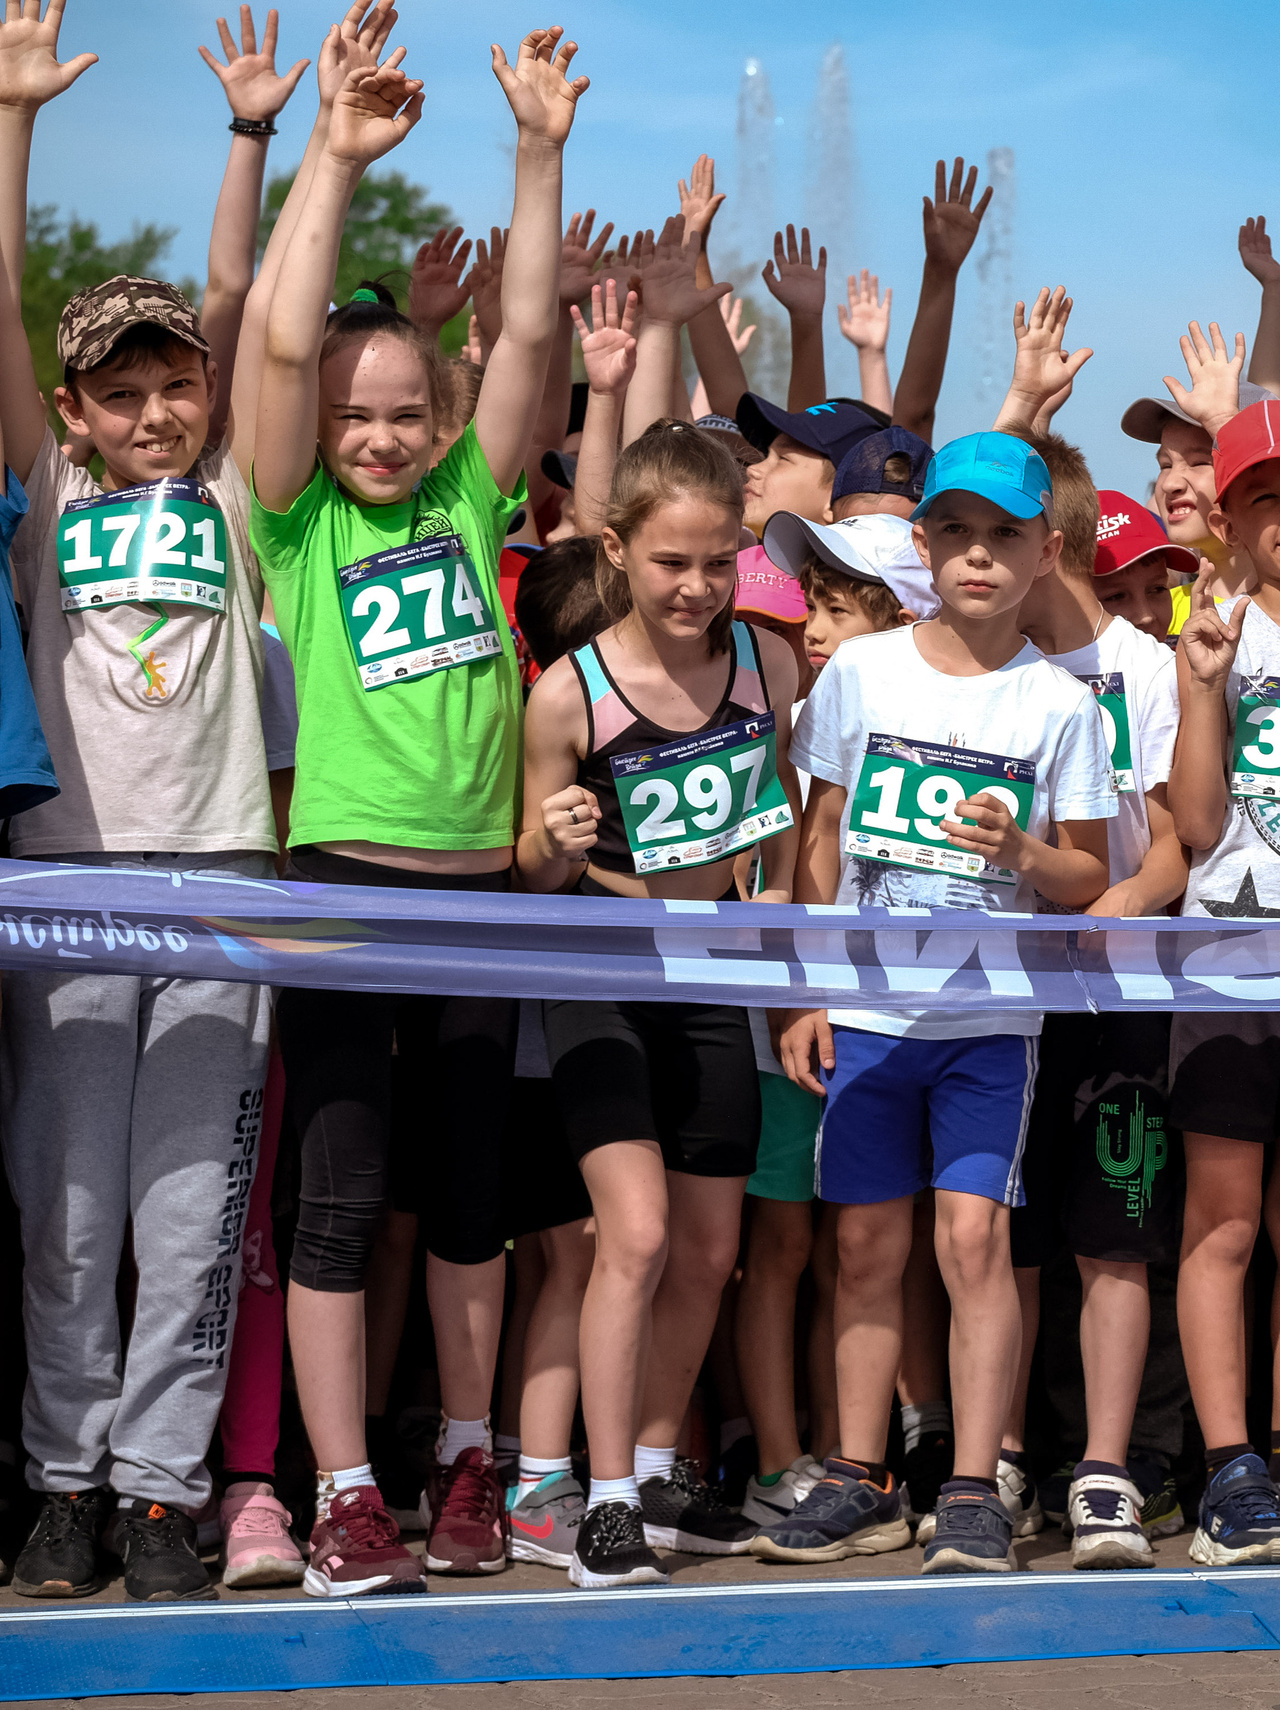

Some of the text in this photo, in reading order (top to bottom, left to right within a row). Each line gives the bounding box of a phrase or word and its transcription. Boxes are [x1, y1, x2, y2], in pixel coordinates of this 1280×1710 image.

[414, 519, 449, 541] ИЦЕЙ
[1096, 530, 1120, 542] AKAN
[64, 511, 225, 575] 1721
[738, 572, 788, 589] BERTY
[352, 563, 485, 657] 274
[629, 745, 767, 843] 297
[1099, 1103, 1120, 1115] ONE
[1146, 1117, 1164, 1128] STEP
[1126, 1177, 1141, 1218] LEVEL
